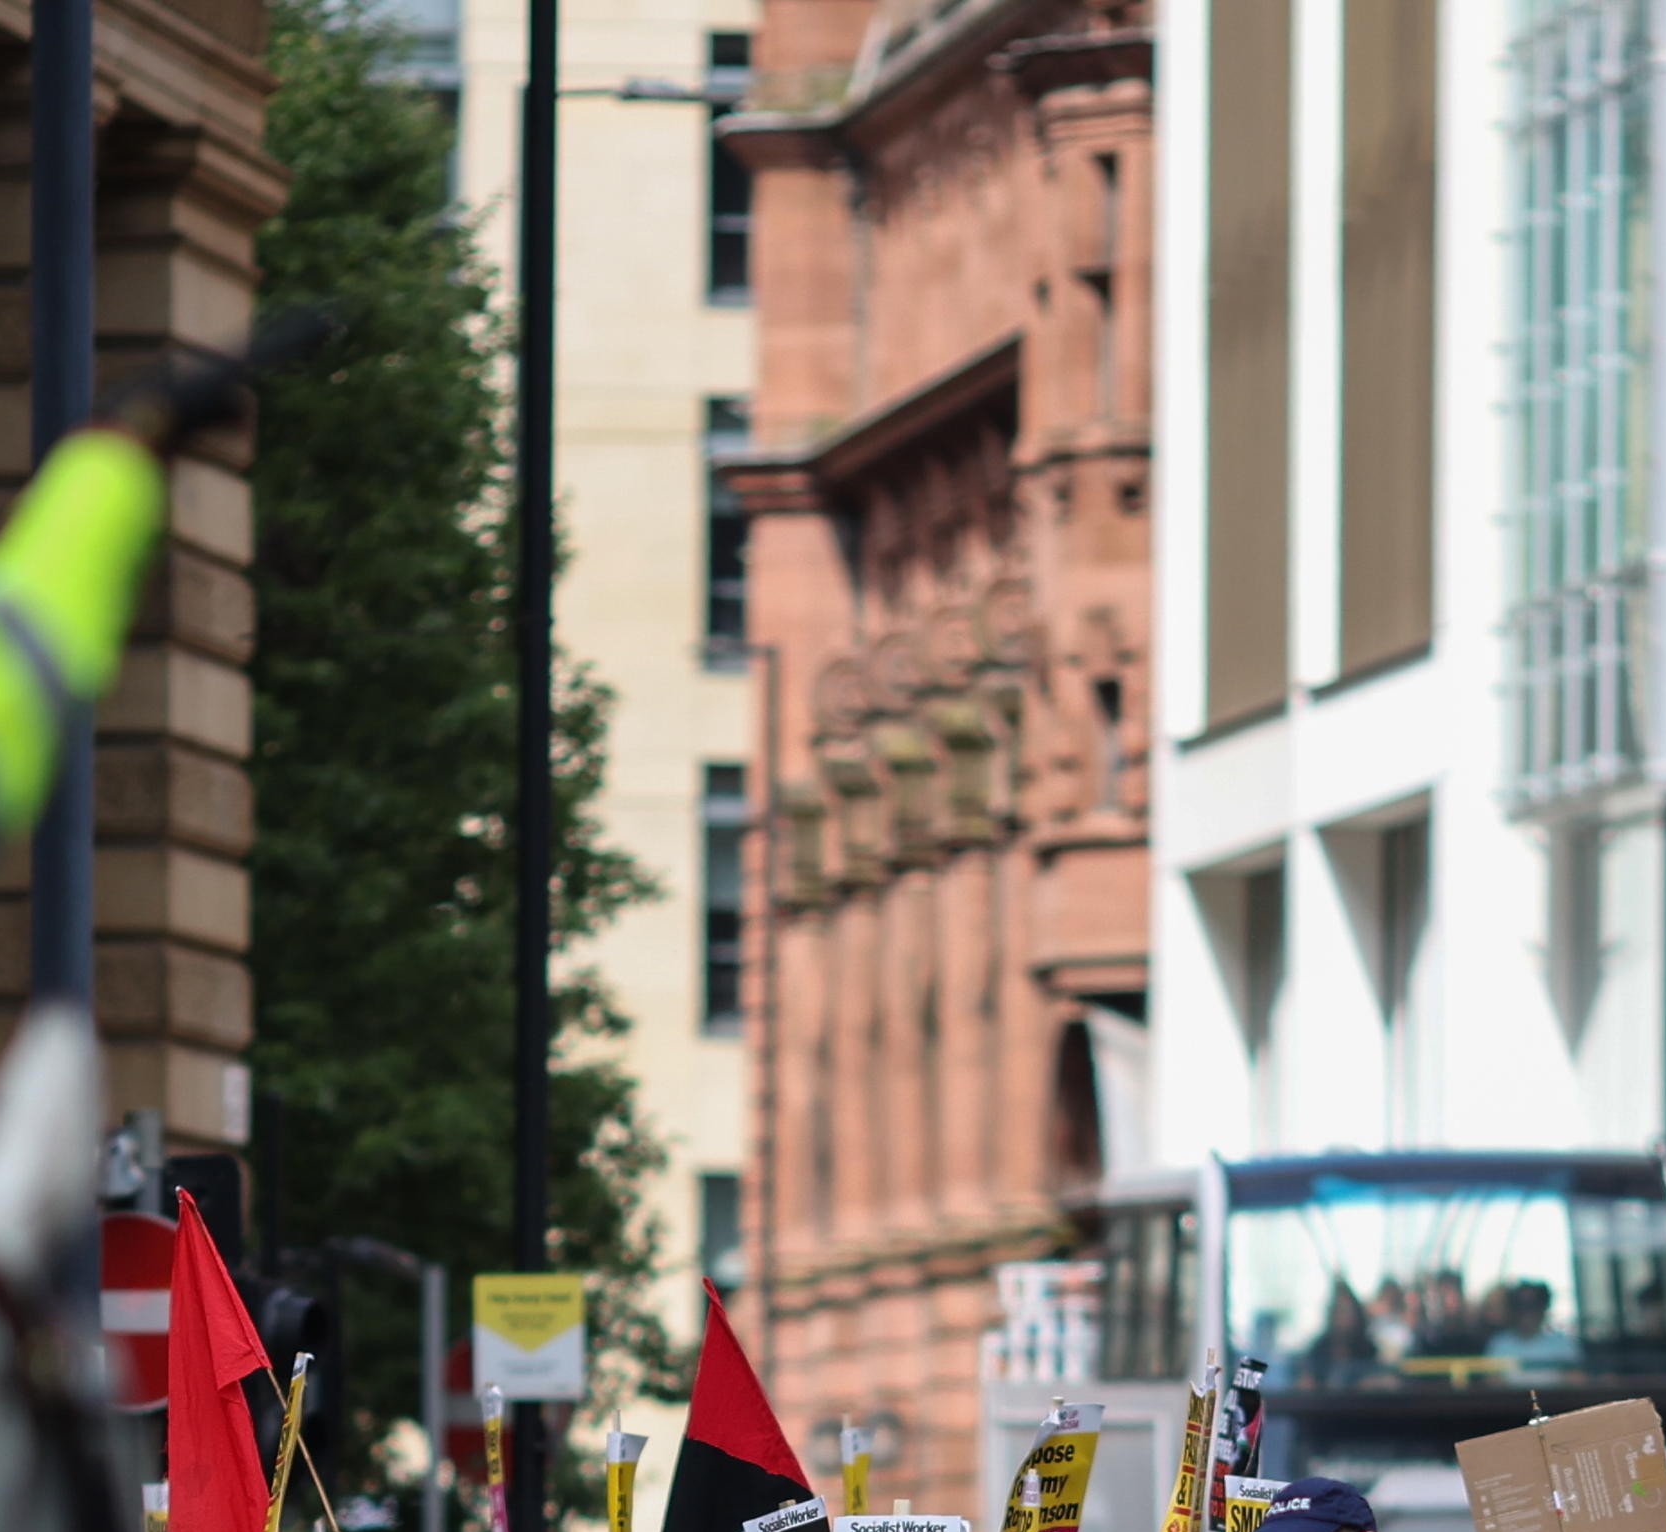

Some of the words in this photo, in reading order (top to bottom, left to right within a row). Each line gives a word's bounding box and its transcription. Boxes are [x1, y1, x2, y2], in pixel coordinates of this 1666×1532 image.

[1025, 1444, 1075, 1471] pose
[788, 1506, 819, 1526] Worker
[1005, 1502, 1079, 1530] Ronson
